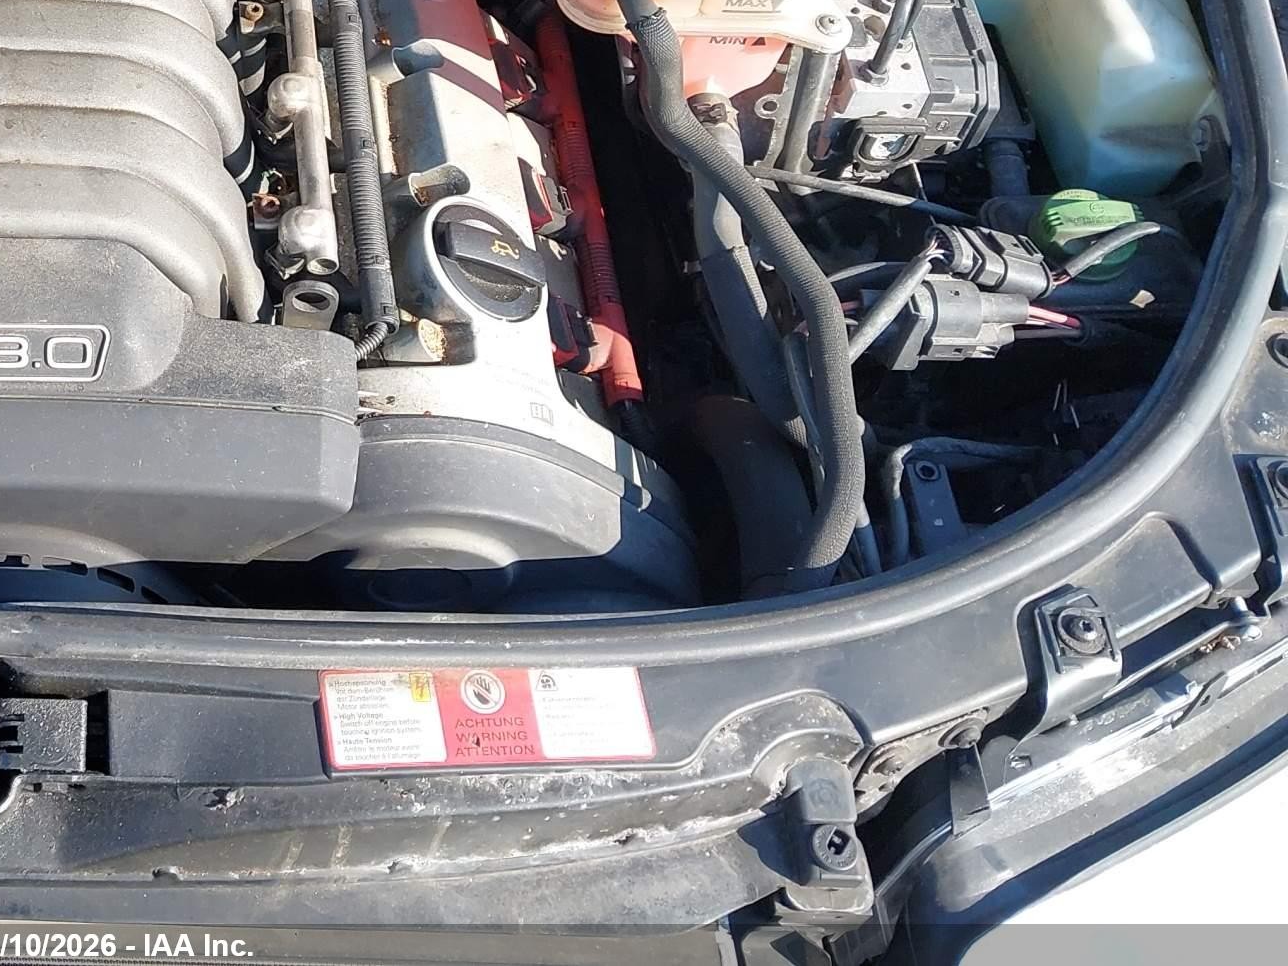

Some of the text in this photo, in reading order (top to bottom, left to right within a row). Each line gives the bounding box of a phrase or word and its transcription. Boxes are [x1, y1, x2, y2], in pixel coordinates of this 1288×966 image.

[709, 36, 747, 45] MIN
[339, 712, 355, 721] High
[455, 716, 525, 730] ACHTUNG
[455, 731, 528, 744] WARNING
[455, 744, 536, 758] ATTENTION
